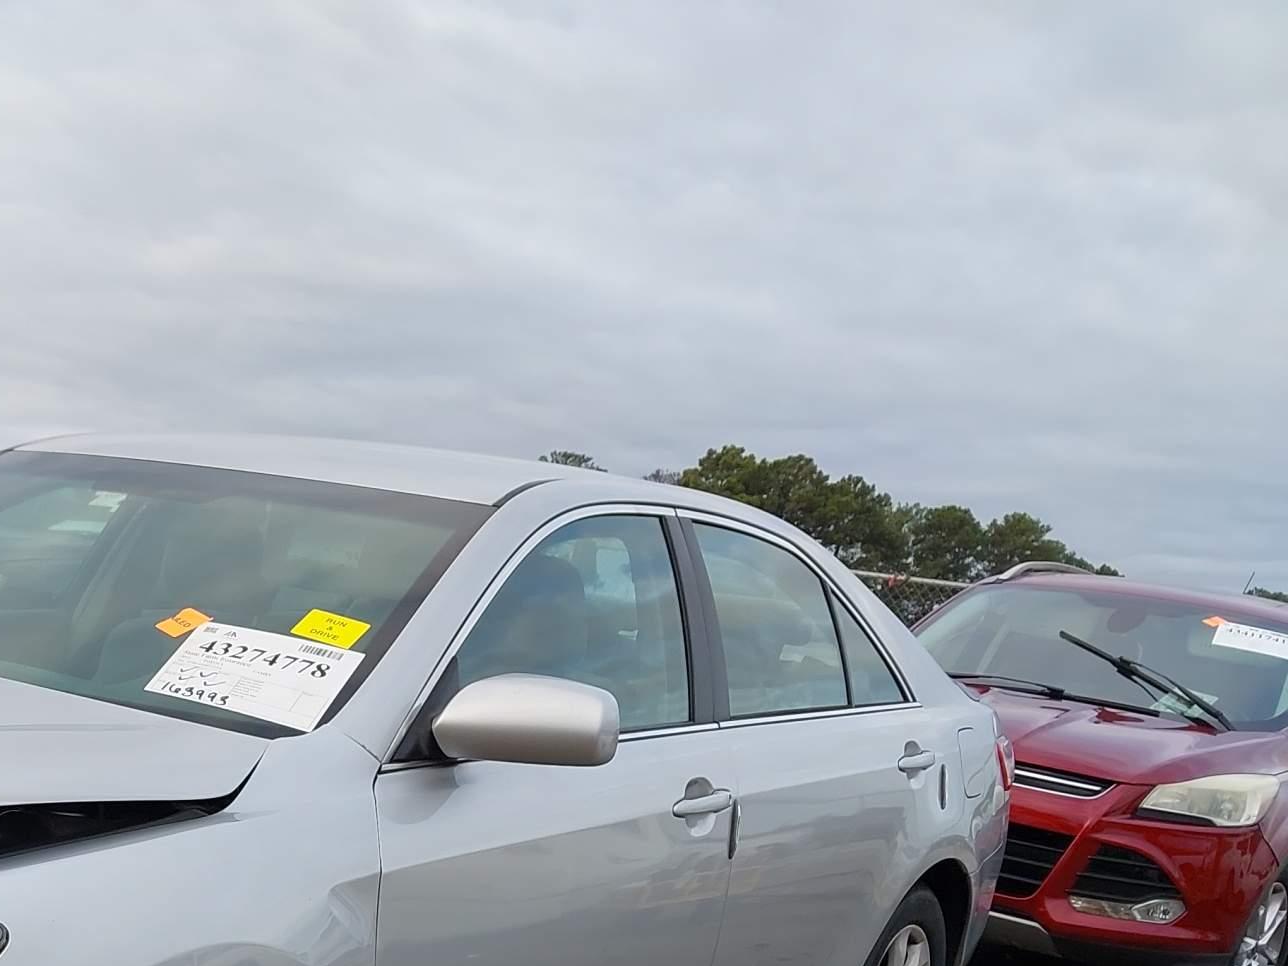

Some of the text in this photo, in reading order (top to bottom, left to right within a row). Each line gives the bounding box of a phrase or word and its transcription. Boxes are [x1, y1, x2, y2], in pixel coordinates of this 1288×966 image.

[326, 618, 349, 629] RUN
[310, 628, 341, 641] DRIVE
[199, 640, 331, 678] 43274778
